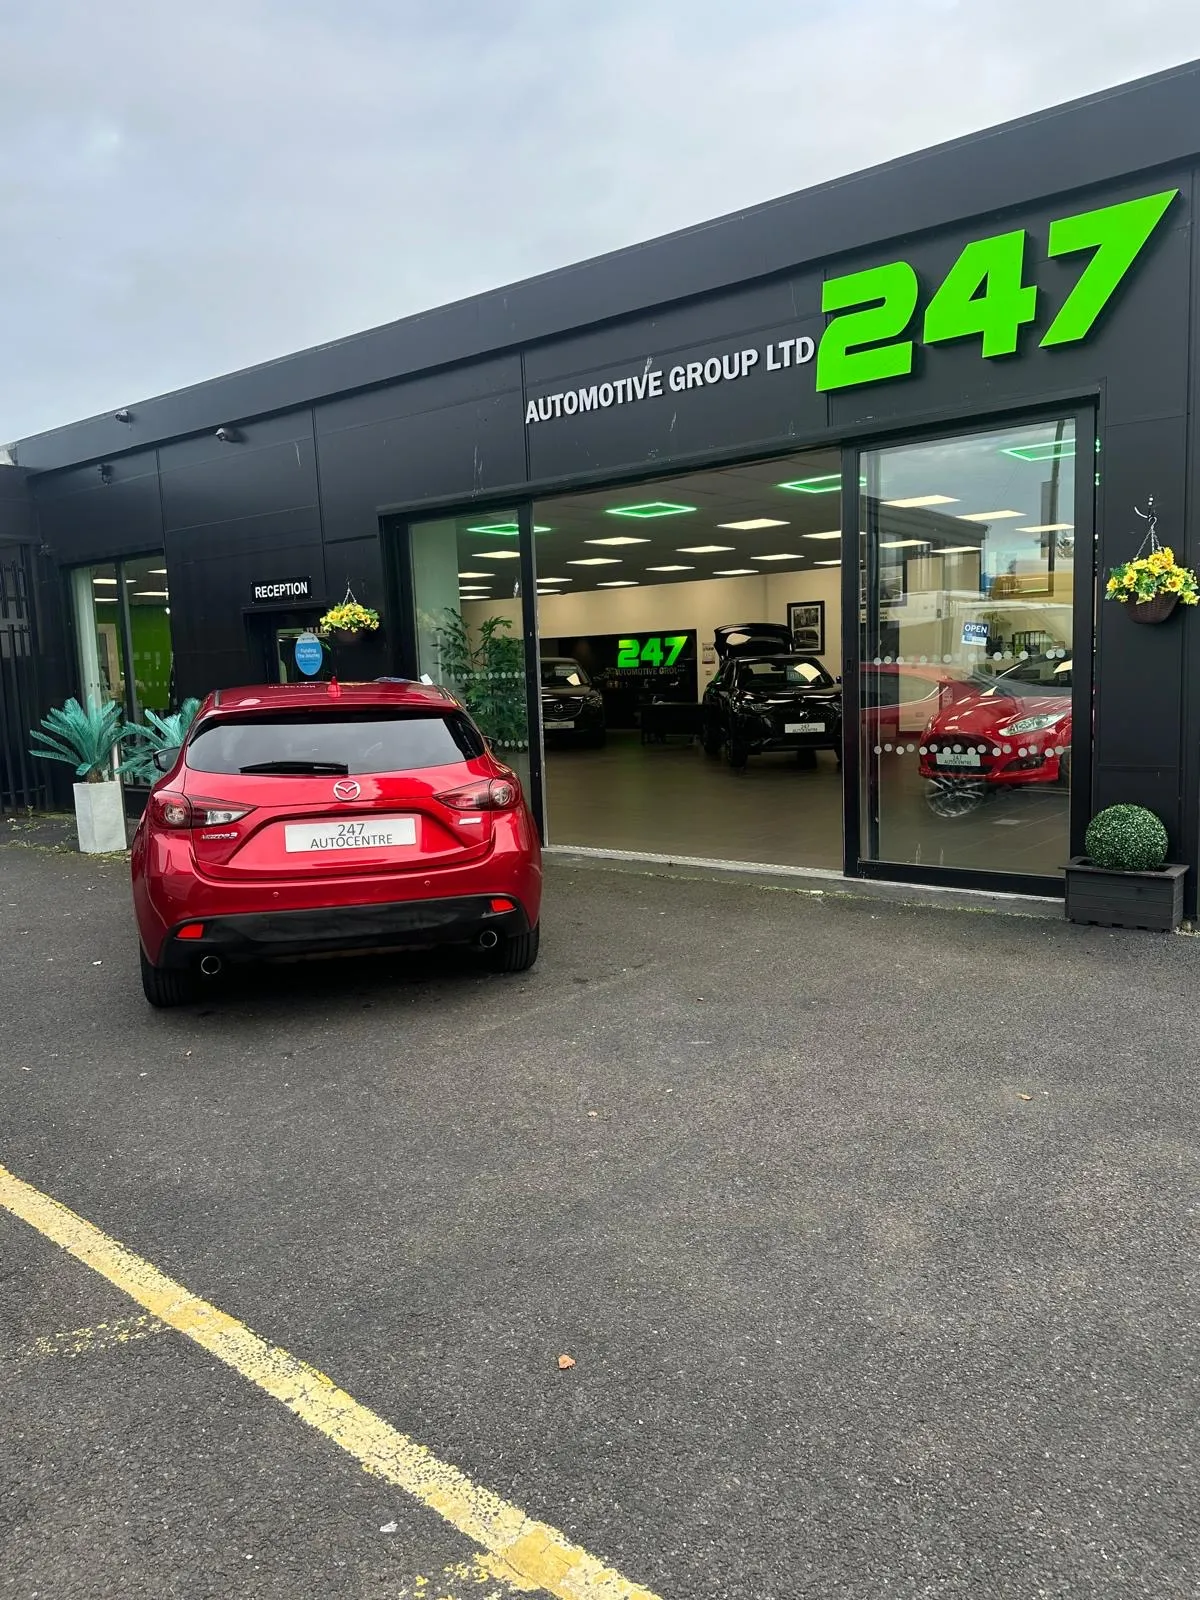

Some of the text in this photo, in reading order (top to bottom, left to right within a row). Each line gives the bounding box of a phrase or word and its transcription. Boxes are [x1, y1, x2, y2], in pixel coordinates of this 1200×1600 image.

[815, 188, 1180, 393] 247
[525, 336, 816, 424] AUTOMOTIVE GROUP LTD
[254, 581, 308, 599] RECEPTION
[964, 623, 988, 634] OPEN
[617, 635, 689, 668] 247
[337, 823, 366, 837] 247
[310, 834, 393, 849] AUTOCENTRE
